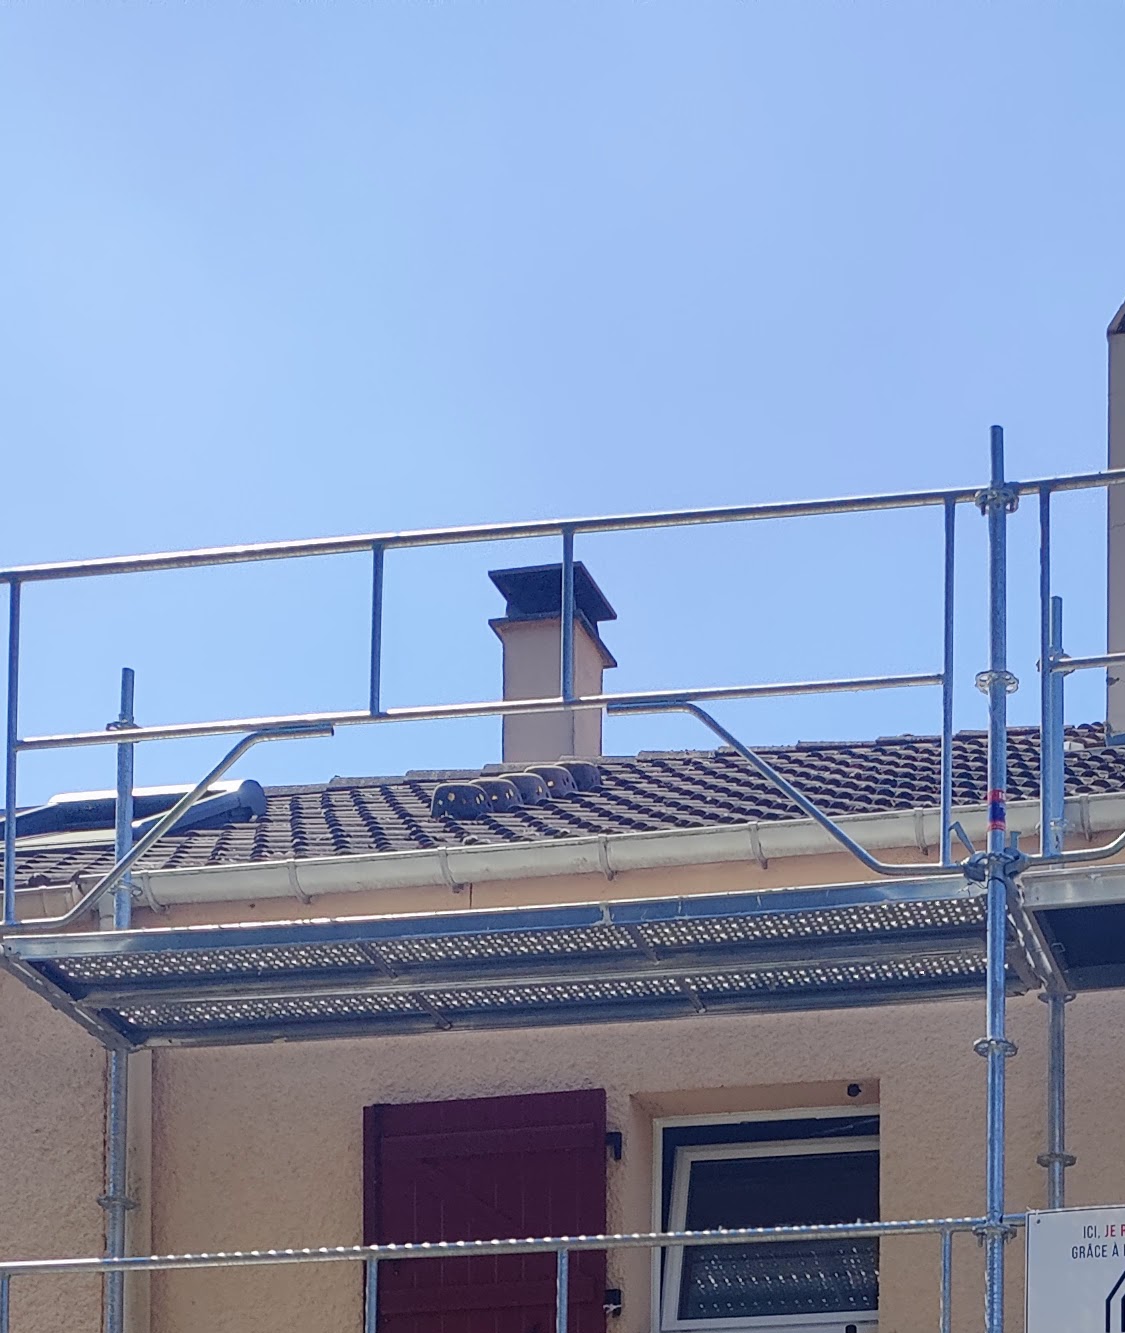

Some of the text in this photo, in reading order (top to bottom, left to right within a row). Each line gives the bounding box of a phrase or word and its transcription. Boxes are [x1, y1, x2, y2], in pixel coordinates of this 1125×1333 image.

[1083, 1225, 1101, 1239] ICI,
[1104, 1224, 1117, 1238] JE
[1071, 1243, 1108, 1259] GRÂCE
[1111, 1242, 1120, 1258] À
